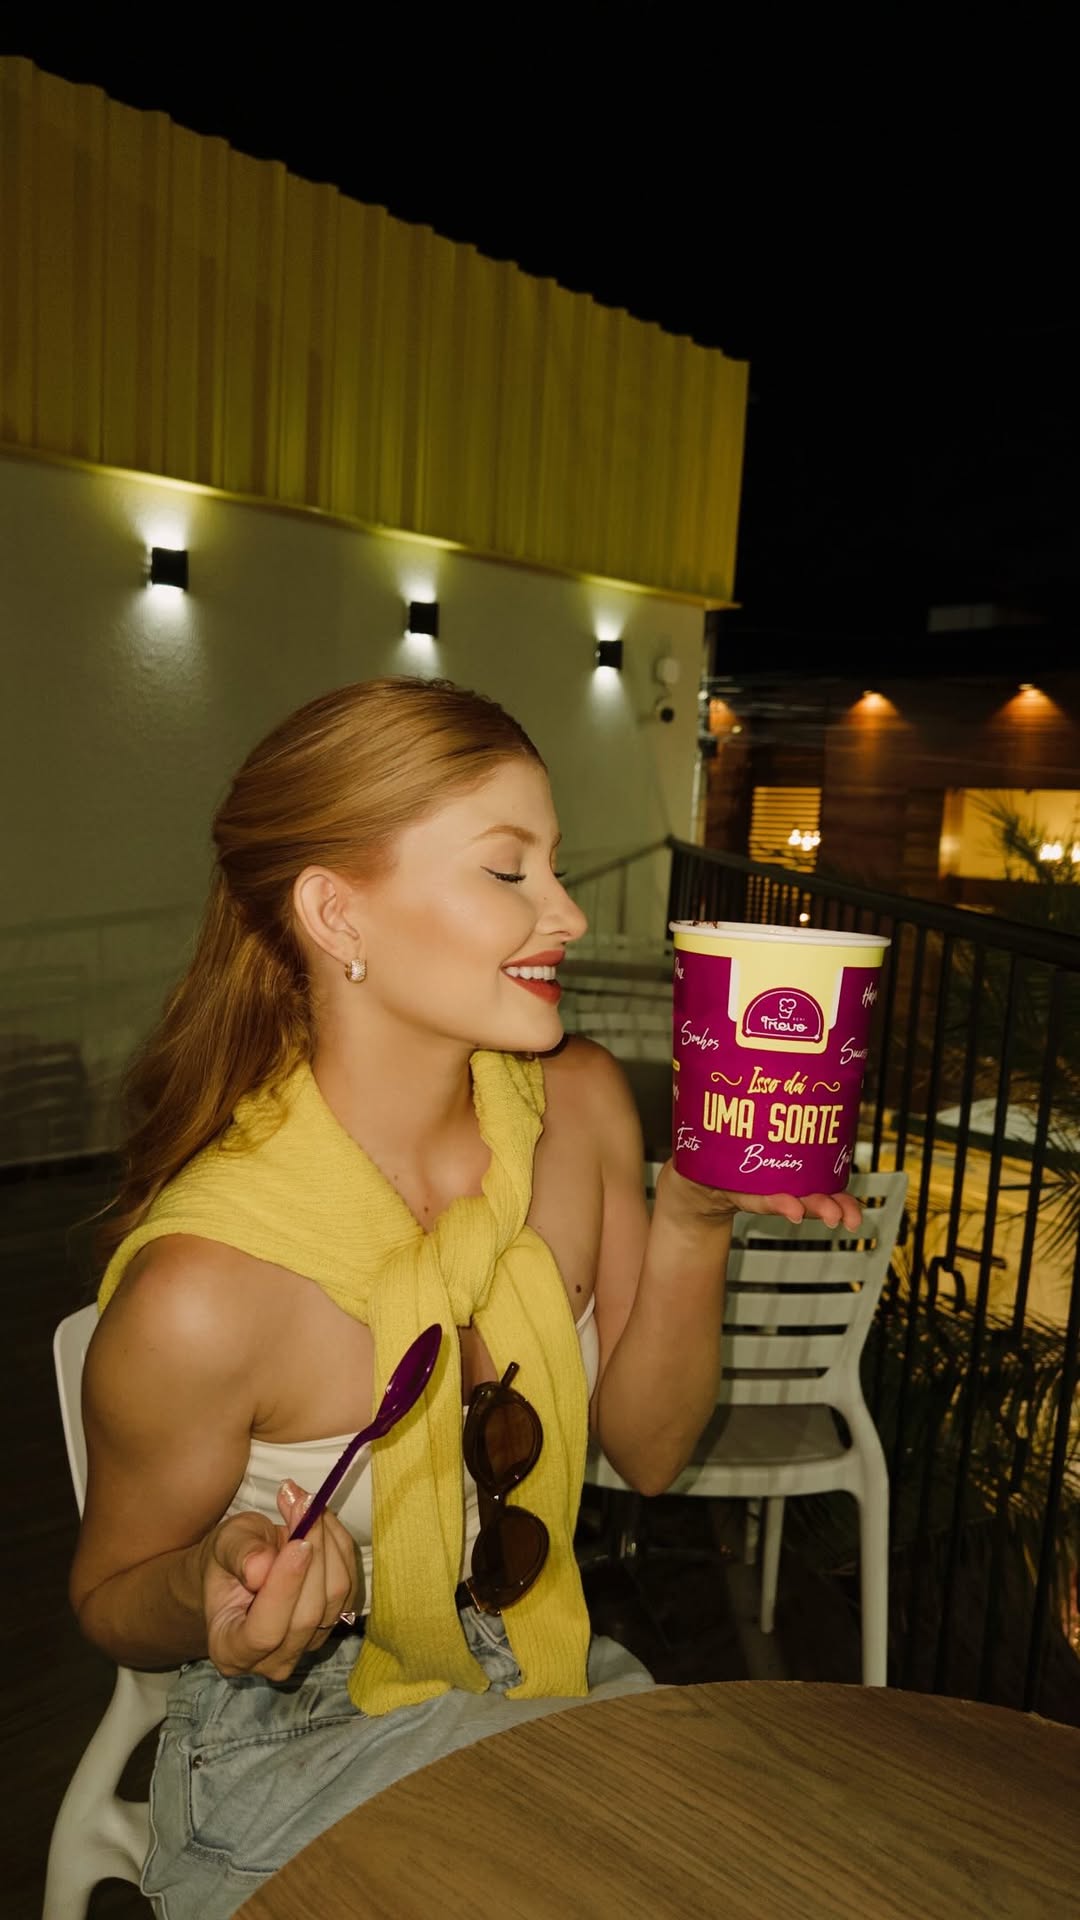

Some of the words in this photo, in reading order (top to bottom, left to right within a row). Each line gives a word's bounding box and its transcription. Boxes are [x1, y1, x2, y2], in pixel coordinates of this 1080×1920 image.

[680, 1020, 720, 1050] Sonhos
[760, 1015, 808, 1032] Trevo
[747, 1066, 782, 1094] Isso
[783, 1071, 809, 1095] dá
[702, 1090, 755, 1139] UMA
[767, 1102, 844, 1145] SORTE
[738, 1143, 803, 1174] Bençãos
